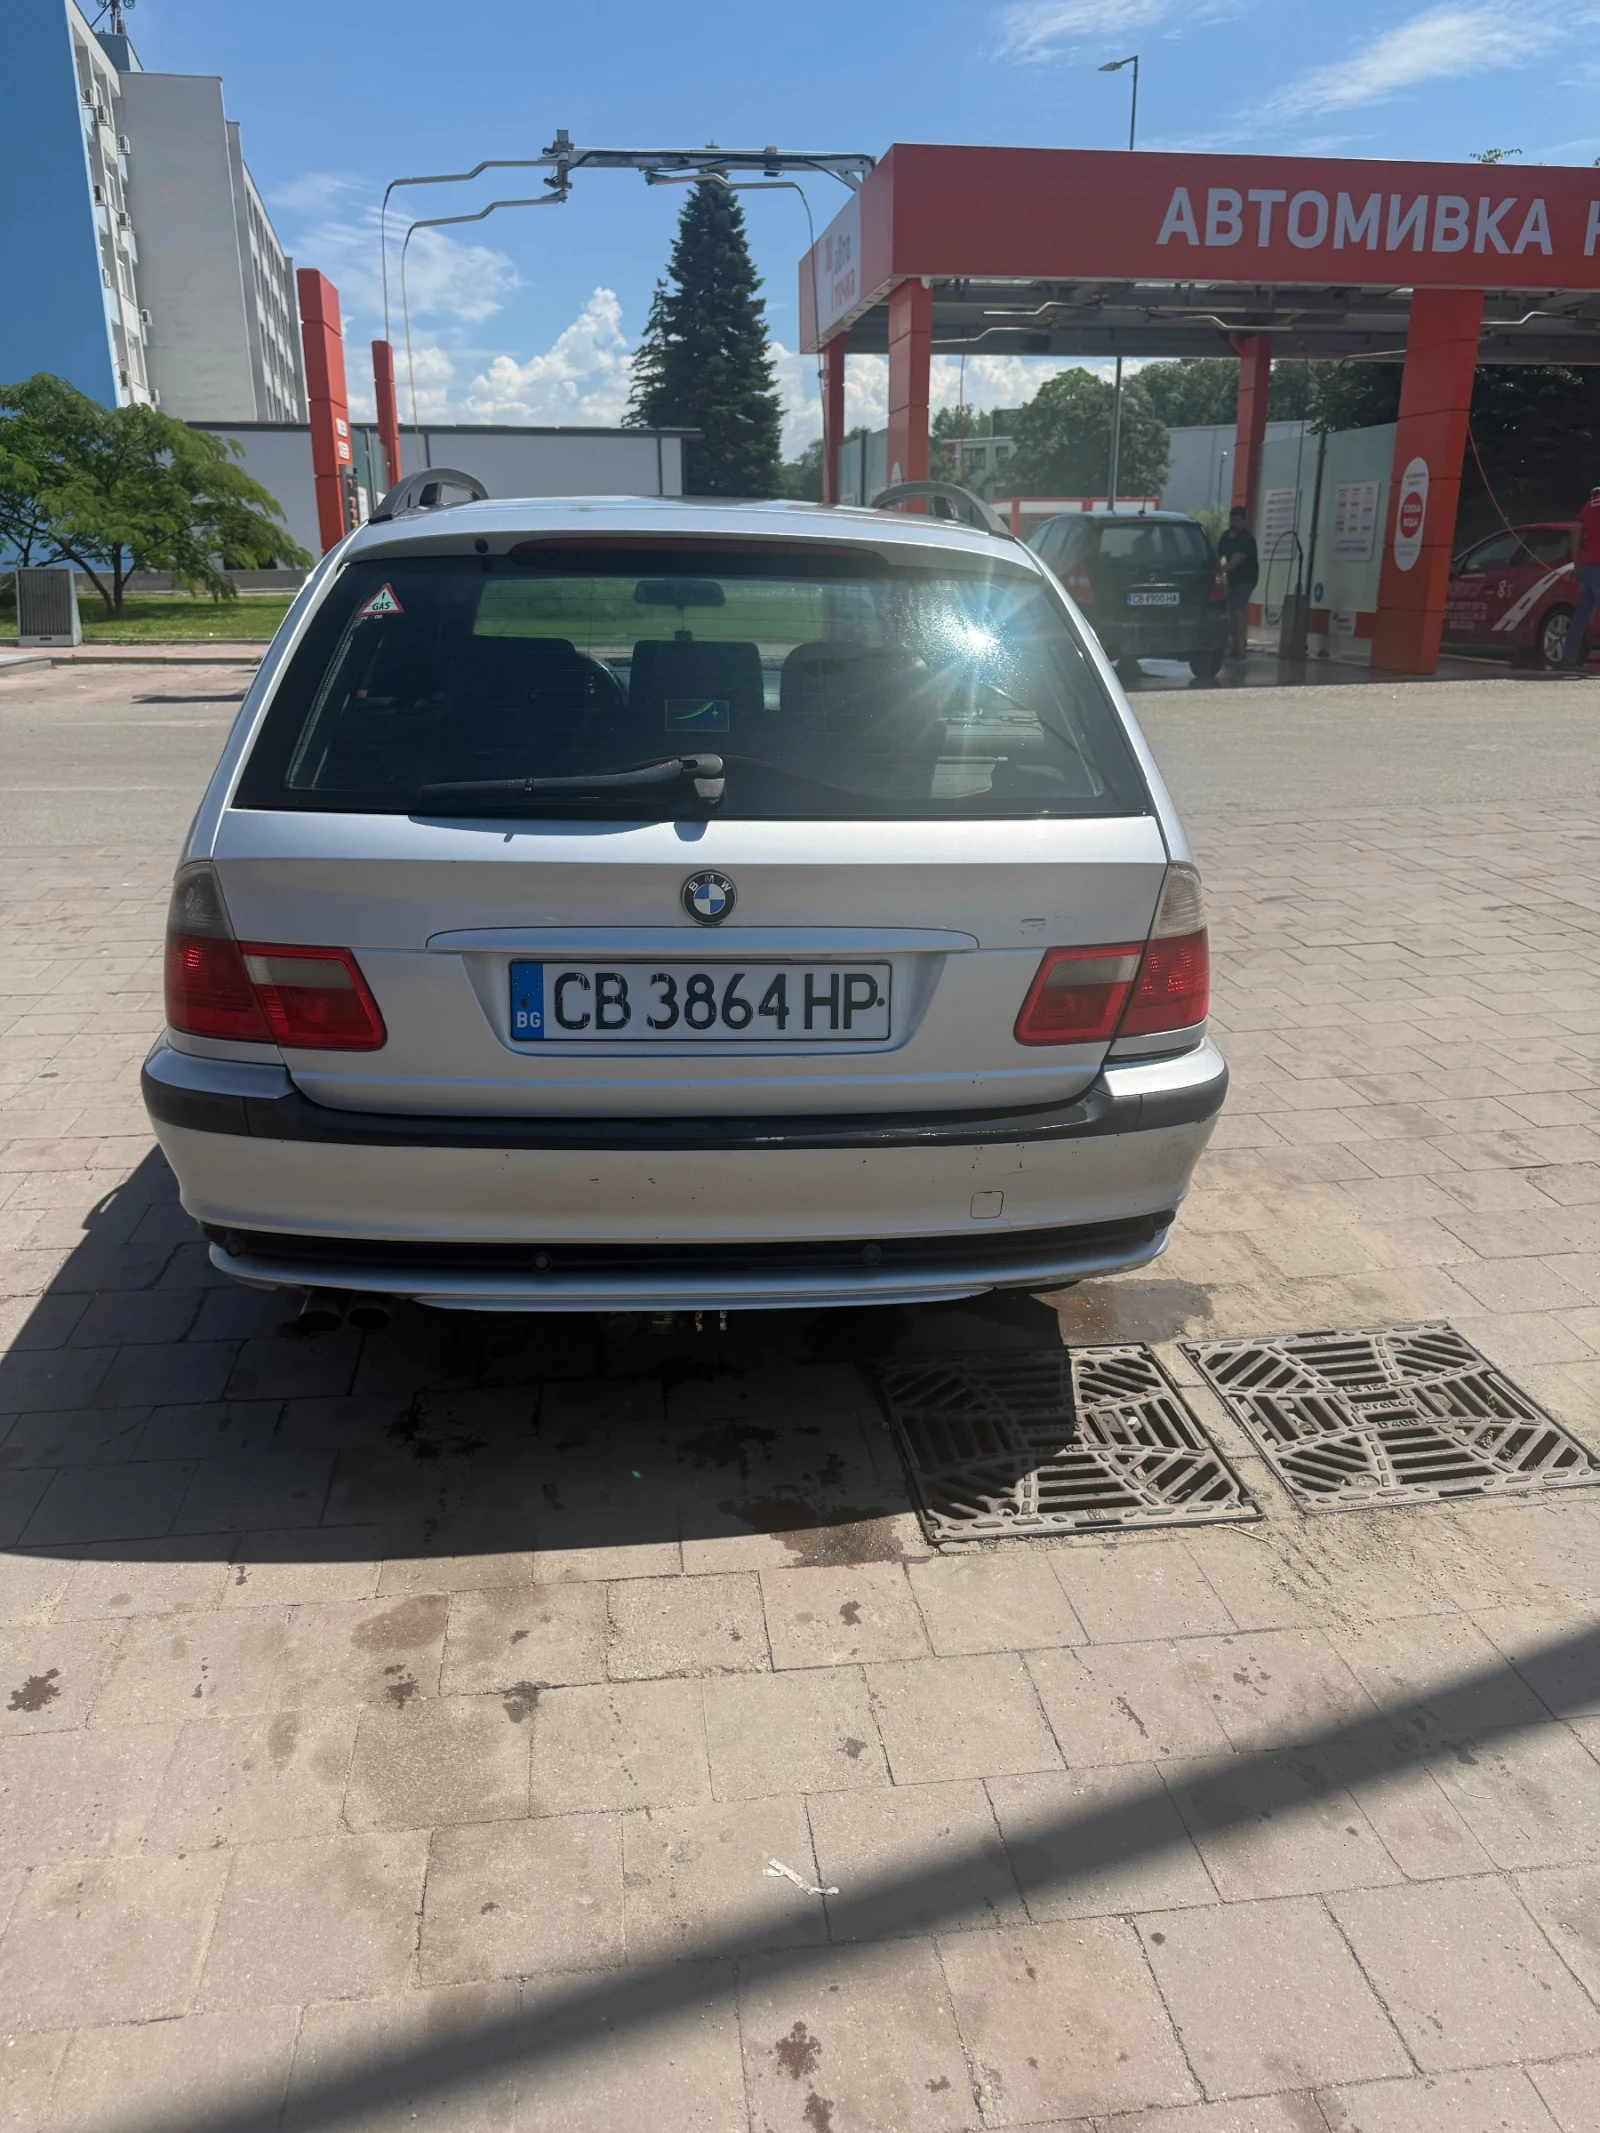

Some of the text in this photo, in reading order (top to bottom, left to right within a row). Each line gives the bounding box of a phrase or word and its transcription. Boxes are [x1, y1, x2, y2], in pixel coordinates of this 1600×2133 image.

[1156, 186, 1553, 255] АВТОМИВКА
[372, 601, 391, 611] GAS
[688, 874, 731, 892] BMW
[554, 972, 879, 1030] CB 3864 HP
[516, 1011, 541, 1028] BG
[1391, 1418, 1420, 1429] 400
